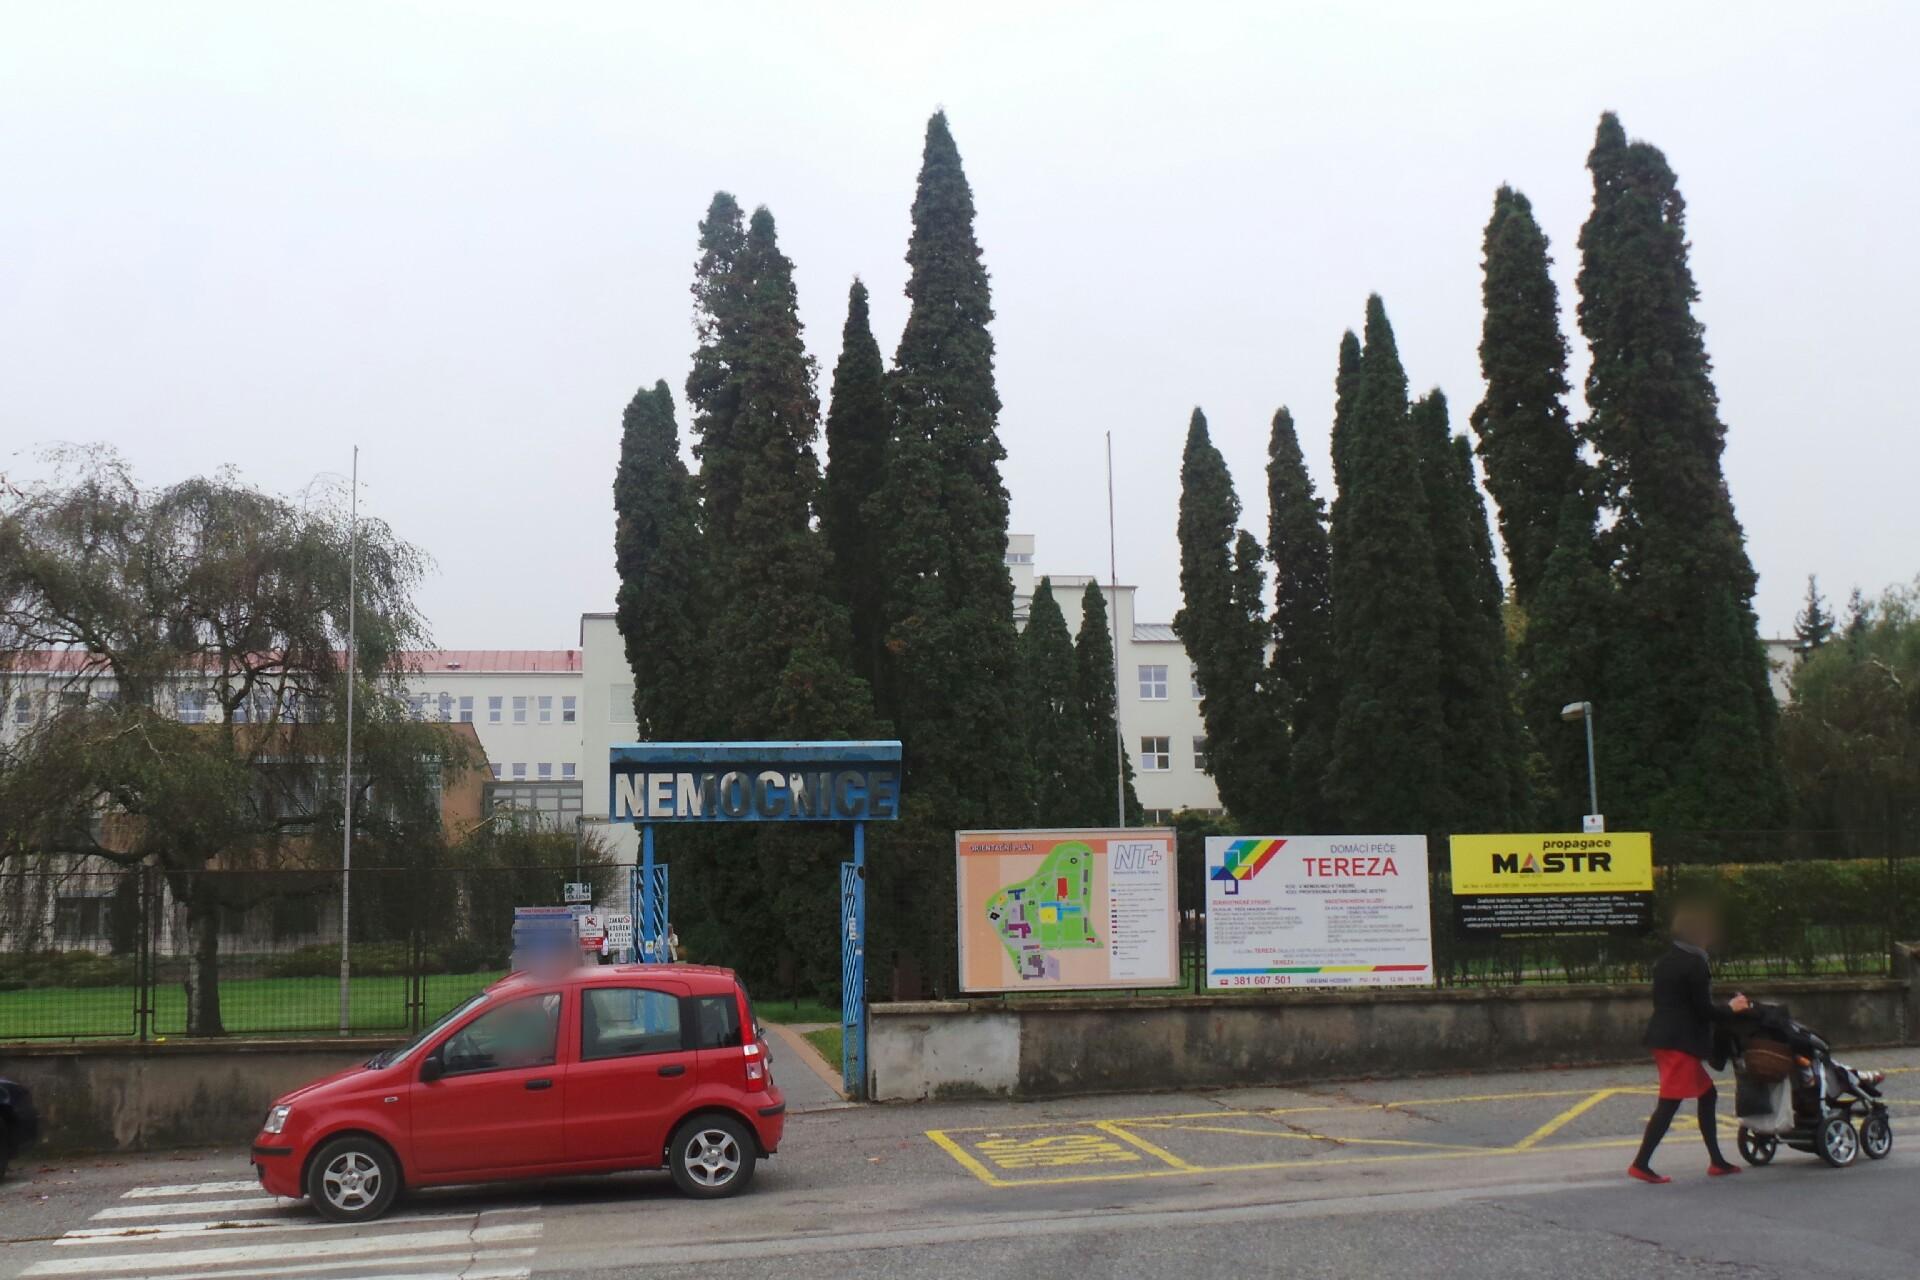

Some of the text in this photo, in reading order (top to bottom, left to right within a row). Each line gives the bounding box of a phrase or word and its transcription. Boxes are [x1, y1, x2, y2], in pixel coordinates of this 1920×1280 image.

[614, 770, 896, 818] NEMOCNICE
[1330, 843, 1396, 854] DOMÁCÍ PÉČE
[1543, 839, 1611, 850] propagace
[1302, 857, 1399, 877] TEREZA
[1491, 851, 1612, 874] MASTR
[1234, 977, 1251, 985] 381
[1274, 975, 1291, 984] 501
[974, 1134, 1142, 1169] BUS
